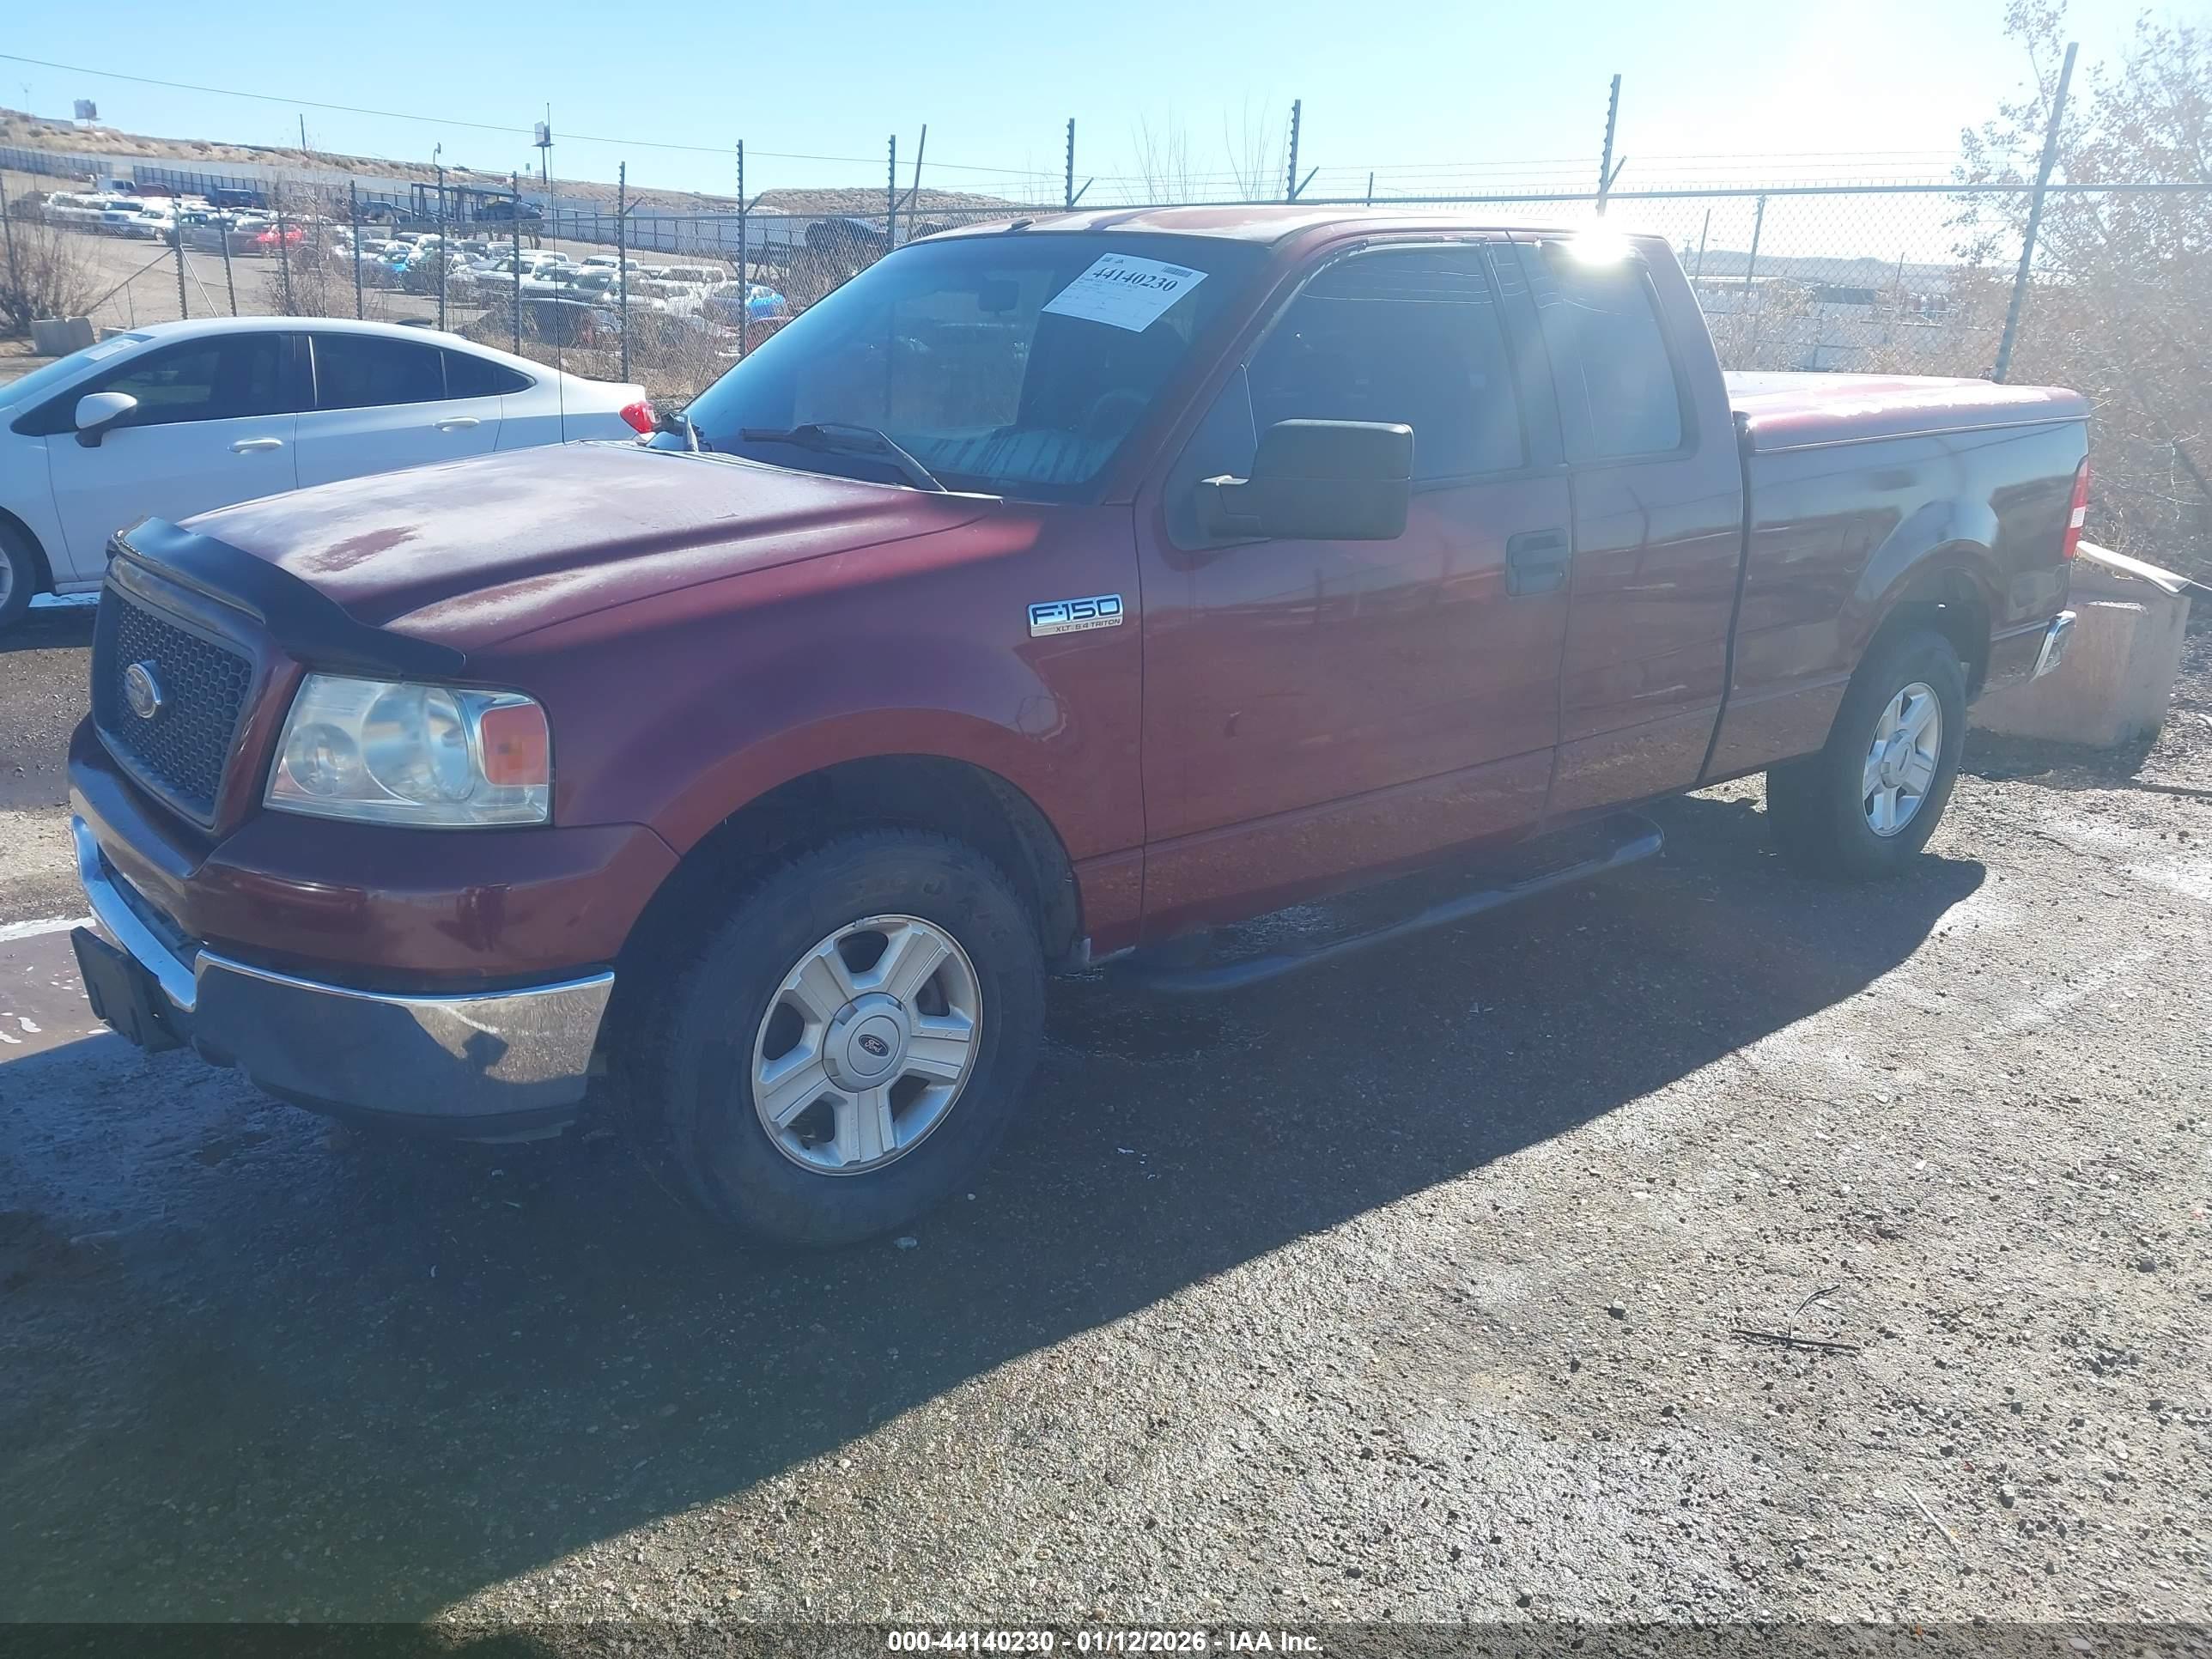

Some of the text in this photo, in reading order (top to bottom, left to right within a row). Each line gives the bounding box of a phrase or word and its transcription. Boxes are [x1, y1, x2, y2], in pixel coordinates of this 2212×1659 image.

[1093, 267, 1179, 292] 44140230
[1031, 598, 1121, 625] F-150
[1091, 618, 1121, 628] TRITON
[865, 1039, 883, 1053] Ford
